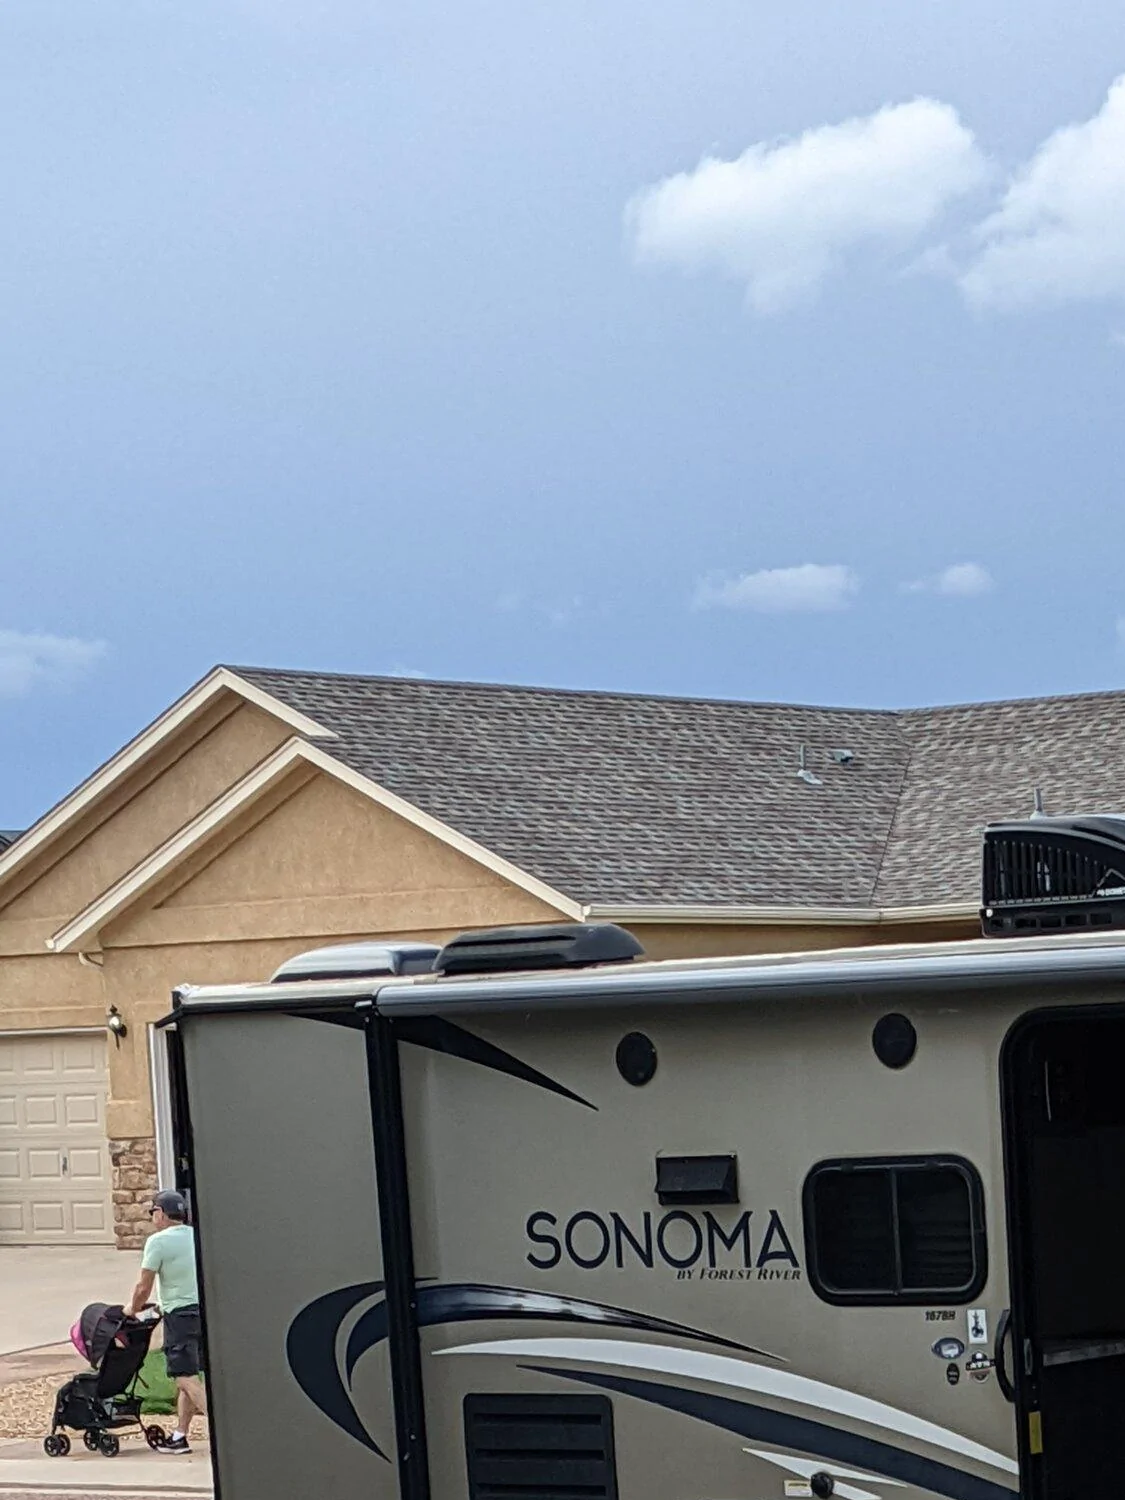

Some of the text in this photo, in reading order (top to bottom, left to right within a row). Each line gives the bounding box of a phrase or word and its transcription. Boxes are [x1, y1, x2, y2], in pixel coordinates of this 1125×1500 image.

[526, 1210, 799, 1270] SONOMA
[699, 1268, 753, 1280] FOREST
[757, 1268, 801, 1280] RIVER
